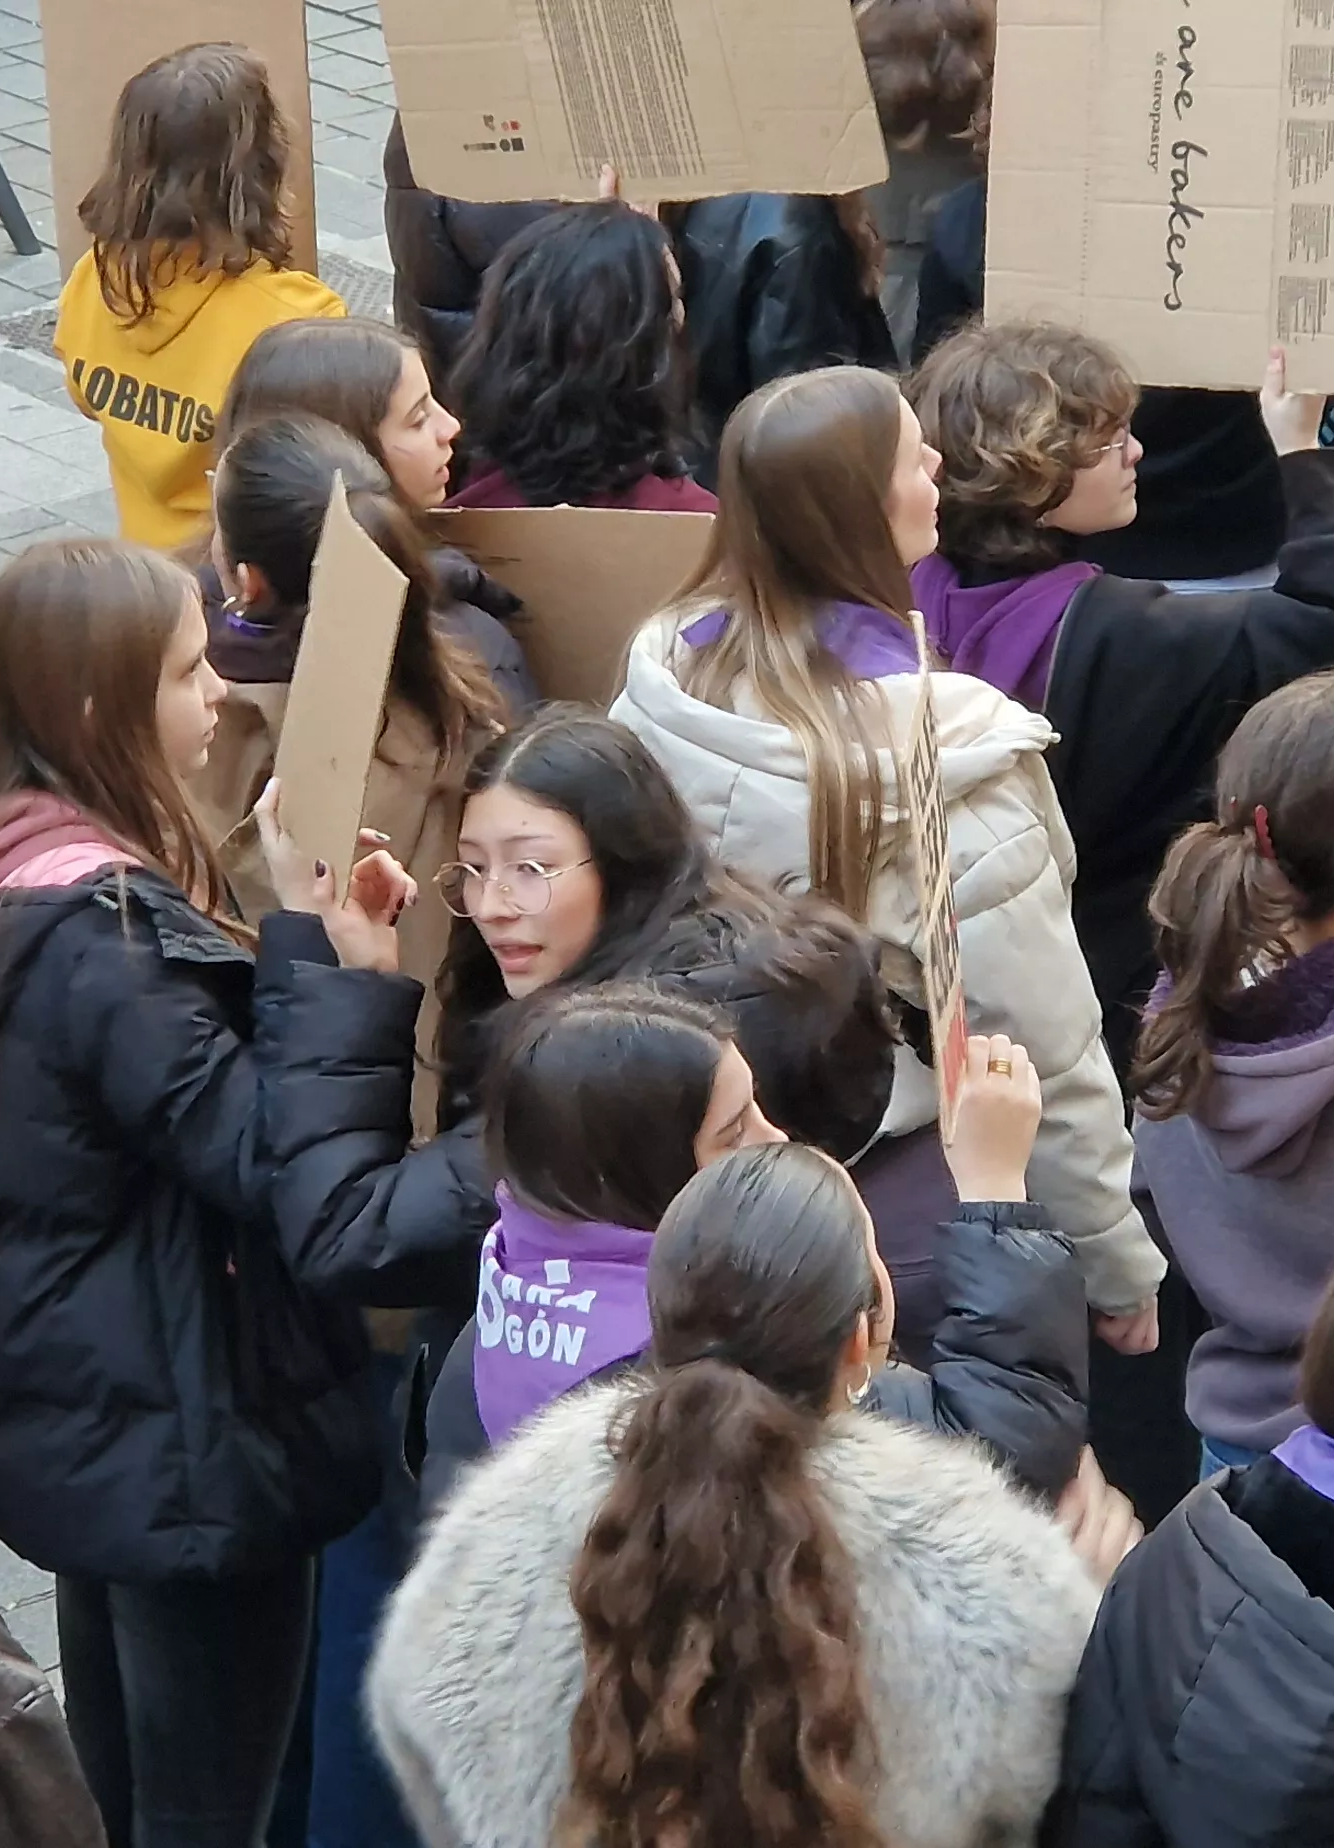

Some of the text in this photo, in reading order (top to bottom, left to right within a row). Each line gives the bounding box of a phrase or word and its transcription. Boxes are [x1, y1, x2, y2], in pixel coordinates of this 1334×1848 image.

[1147, 68, 1164, 175] europastry
[1163, 25, 1208, 311] are bakers
[505, 1308, 587, 1366] GÓN
